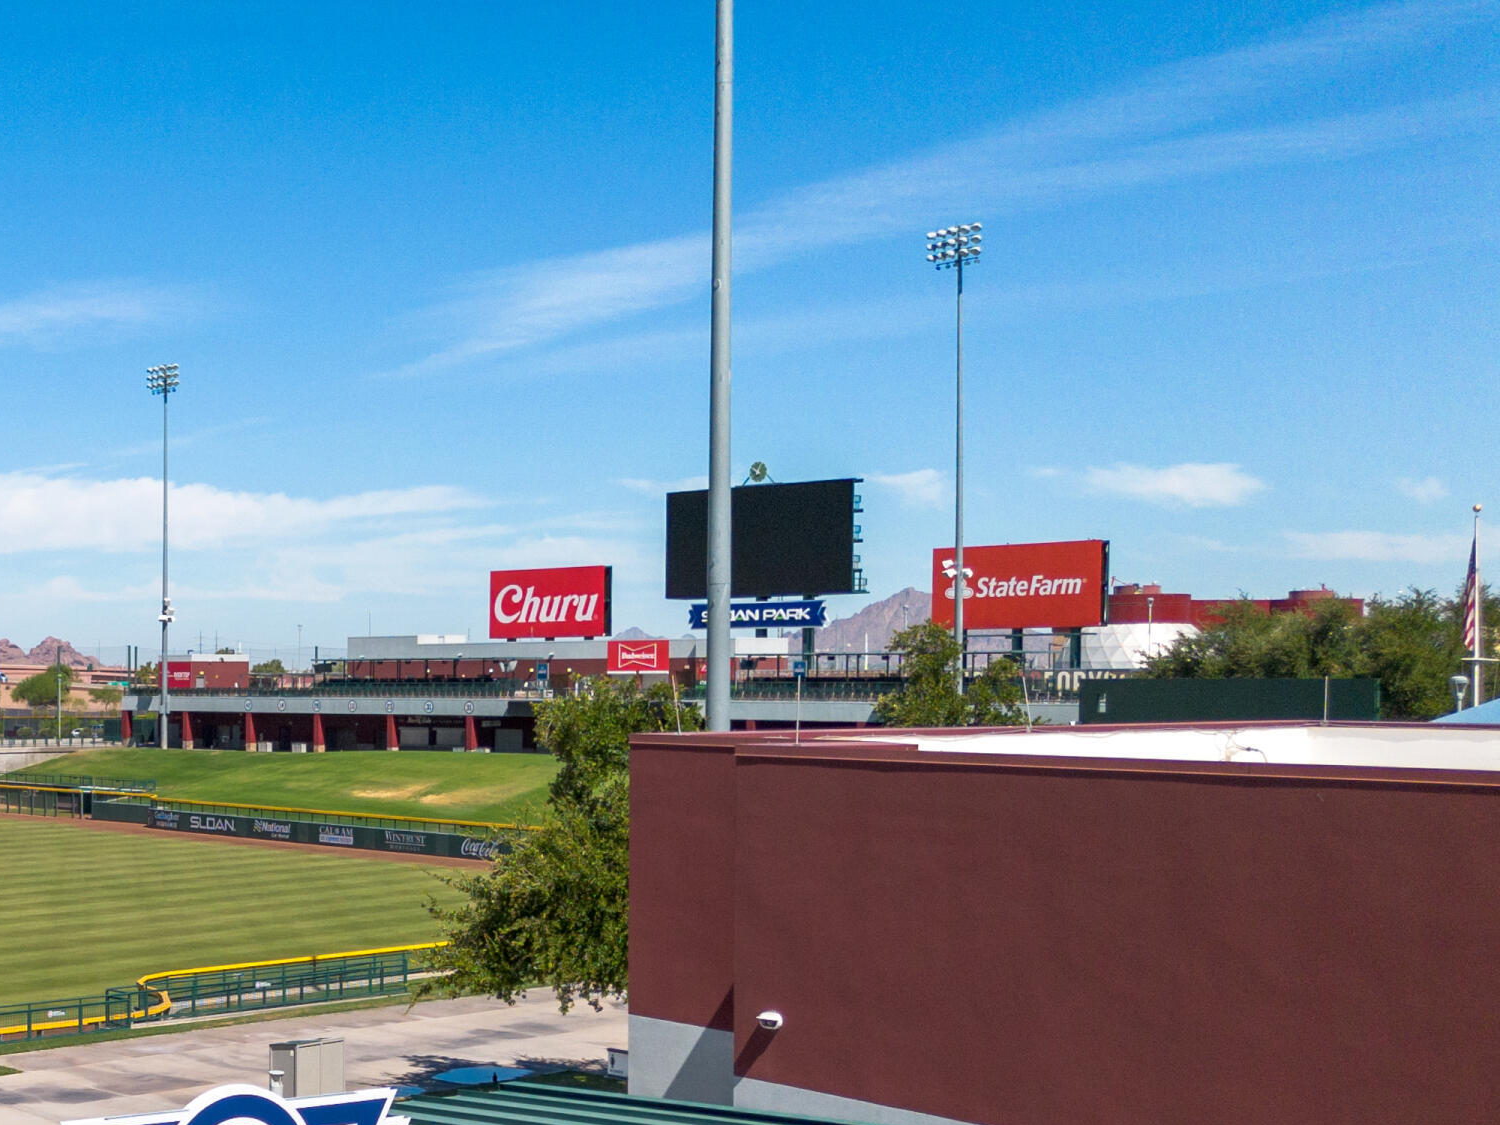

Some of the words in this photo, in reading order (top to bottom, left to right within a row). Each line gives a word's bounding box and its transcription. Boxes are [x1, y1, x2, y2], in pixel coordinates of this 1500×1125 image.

[494, 584, 599, 624] Churu
[701, 609, 760, 623] SAN
[763, 608, 811, 621] PARK
[190, 815, 235, 832] SLOAN
[261, 821, 291, 834] National
